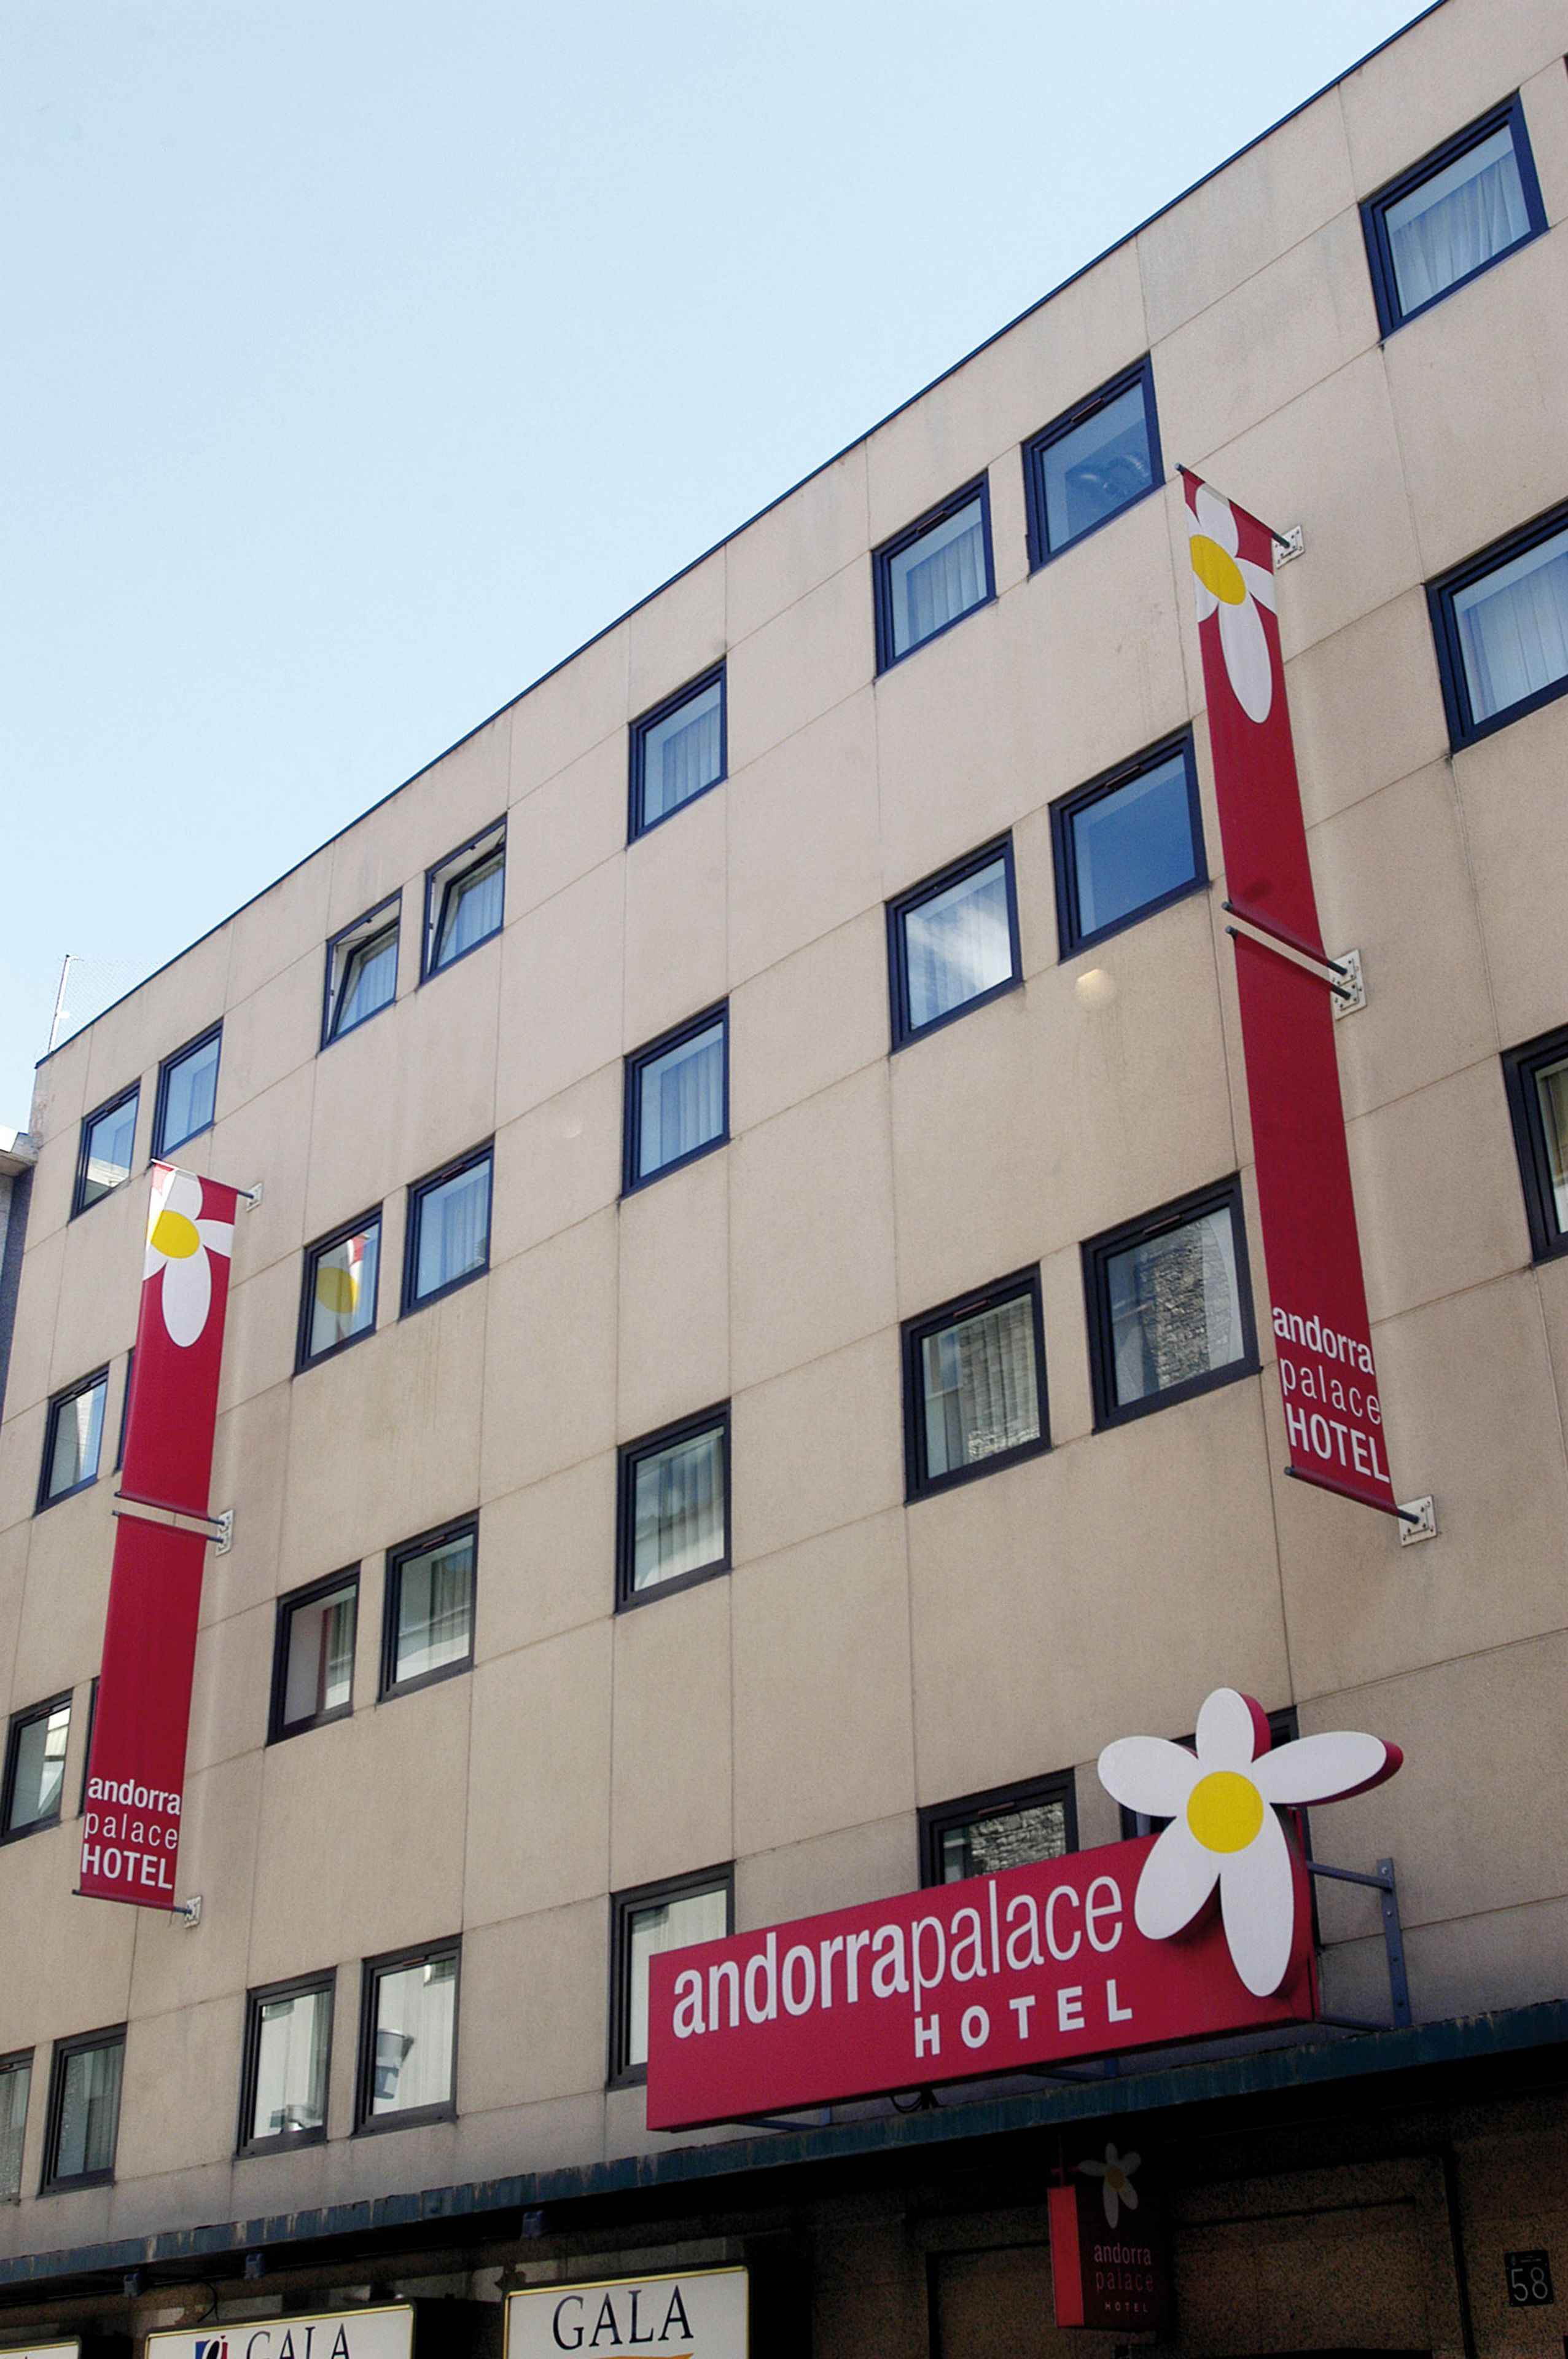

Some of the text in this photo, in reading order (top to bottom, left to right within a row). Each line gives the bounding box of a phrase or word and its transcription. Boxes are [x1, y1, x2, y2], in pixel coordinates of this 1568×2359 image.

[1272, 1307, 1375, 1376] andorra
[1280, 1358, 1381, 1425] palace
[1285, 1402, 1391, 1484] HOTEL
[88, 1777, 181, 1816] andorra
[84, 1812, 179, 1850] palace
[82, 1843, 173, 1890] HOTEL
[914, 1979, 1133, 2059] HOTEL
[1093, 2242, 1152, 2266] andorra
[1095, 2267, 1155, 2293] palace
[1511, 2266, 1548, 2302] 58
[552, 2285, 695, 2351] GALA
[1104, 2300, 1150, 2314] HOTEL
